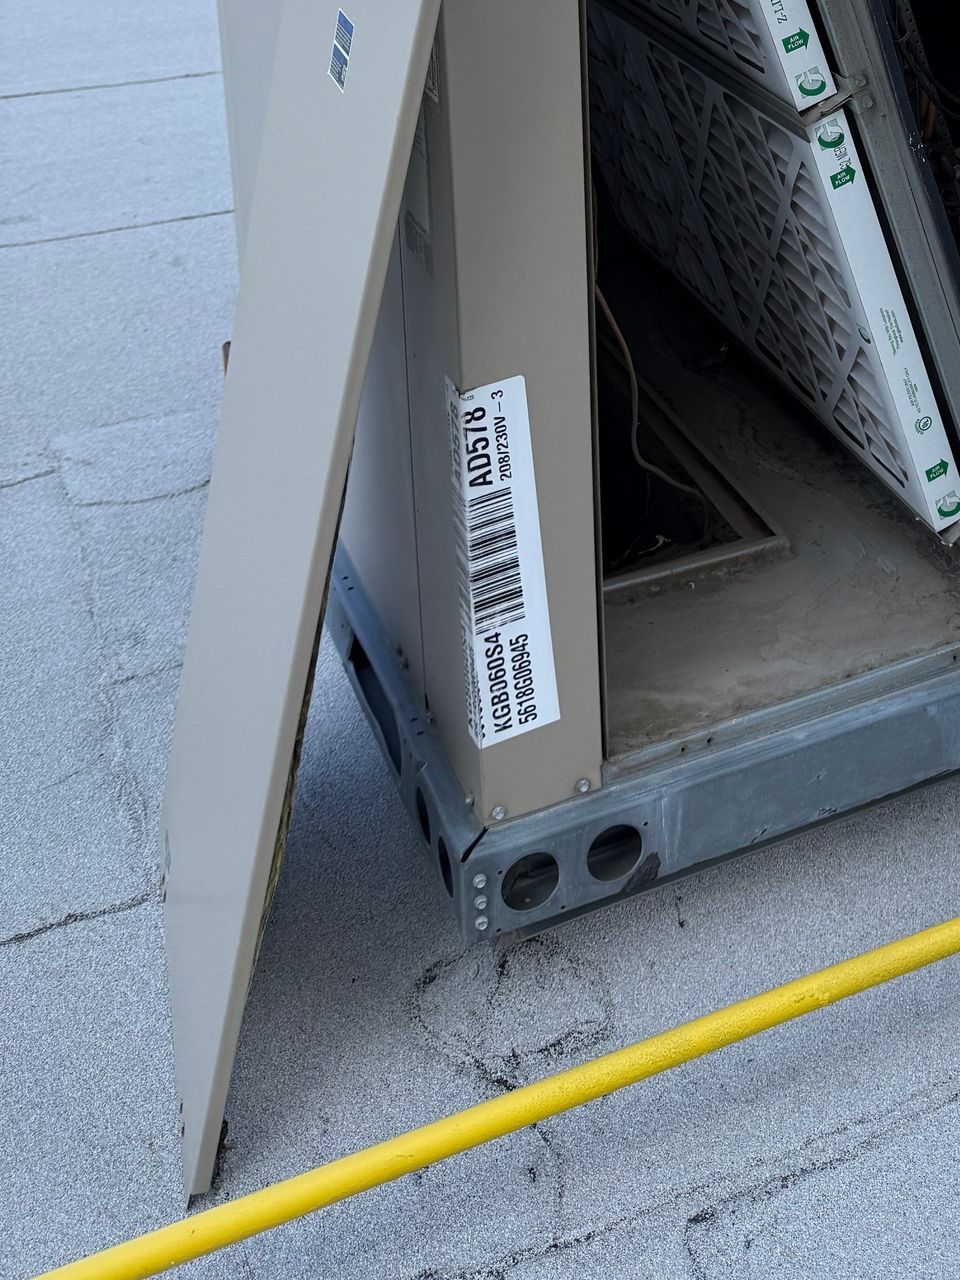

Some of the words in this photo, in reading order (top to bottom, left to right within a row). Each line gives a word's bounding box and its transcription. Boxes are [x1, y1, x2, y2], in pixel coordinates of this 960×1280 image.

[787, 39, 804, 49] FLOW
[789, 35, 800, 43] AIR
[835, 175, 850, 186] FLOW
[837, 171, 846, 179] AIR
[462, 406, 494, 488] AD578
[494, 416, 513, 482] 208/230V
[930, 468, 944, 479] FLOW
[483, 631, 514, 734] KGB060S4
[508, 632, 538, 724] 5618G06945
